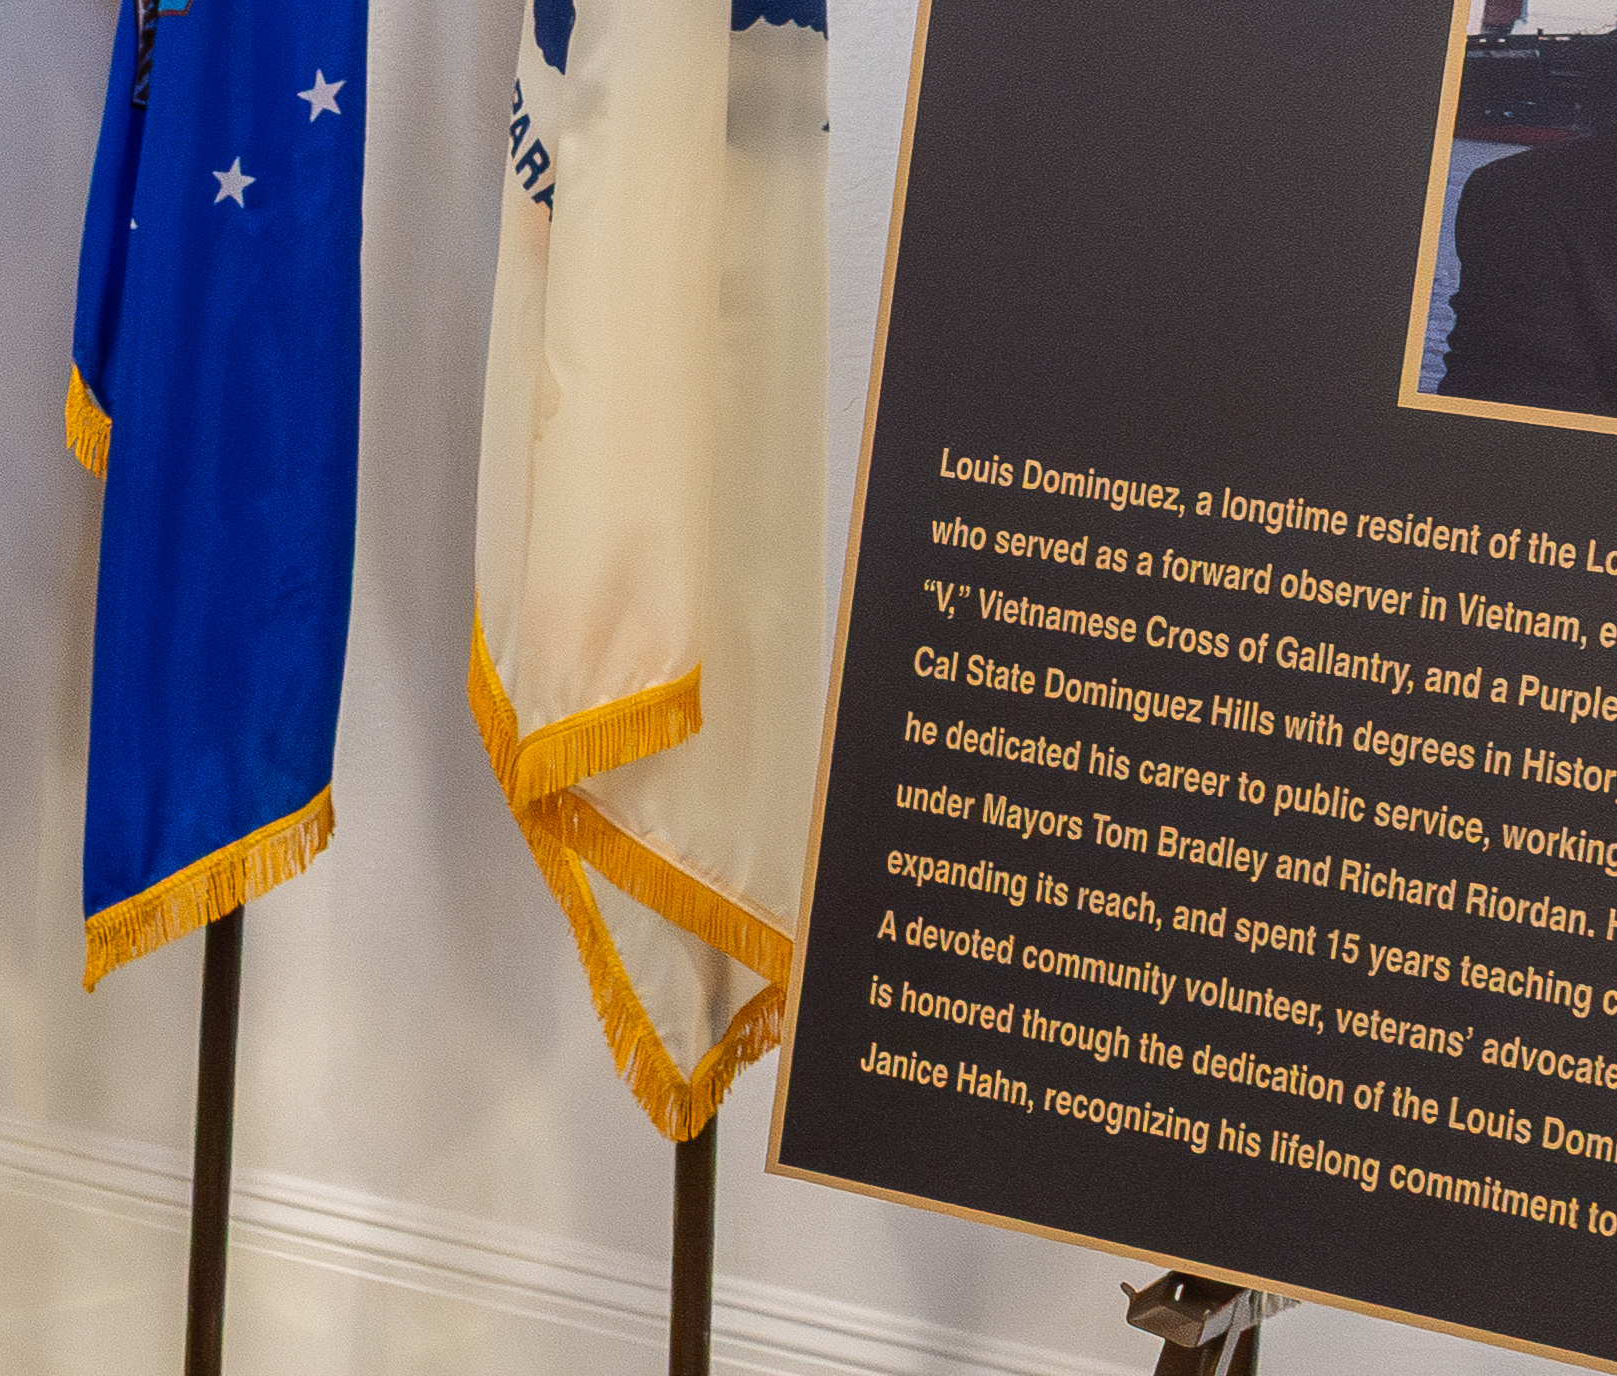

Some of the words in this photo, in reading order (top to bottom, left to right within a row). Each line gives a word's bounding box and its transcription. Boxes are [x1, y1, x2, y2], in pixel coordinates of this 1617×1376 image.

[938, 446, 1015, 488] Louis
[1020, 457, 1187, 519] Dominguez,
[1194, 490, 1214, 517] a
[1220, 486, 1349, 537] longtime
[1355, 512, 1482, 556] resident
[1487, 527, 1523, 562] of
[1527, 531, 1578, 570] the
[922, 578, 972, 620] “V,”
[978, 586, 1138, 644] Vietnamese
[1144, 614, 1231, 659] Cross
[1237, 631, 1271, 665] of
[1274, 634, 1415, 696] Gallantry,
[1422, 665, 1484, 701] and
[1488, 676, 1510, 705] a
[930, 515, 988, 552] who
[993, 529, 1090, 567] served
[1094, 544, 1129, 574] as
[1135, 550, 1154, 578] a
[1161, 547, 1274, 596] forward
[1279, 567, 1414, 617] observer
[1418, 585, 1448, 623] in
[1457, 591, 1588, 651] Vietnam,
[858, 1040, 950, 1090] Janice
[955, 1060, 1035, 1115] Hahn,
[1043, 1086, 1211, 1156] recognizing
[1217, 1117, 1262, 1159] his
[1269, 1128, 1382, 1194] lifelong
[1388, 1162, 1581, 1231] commitment
